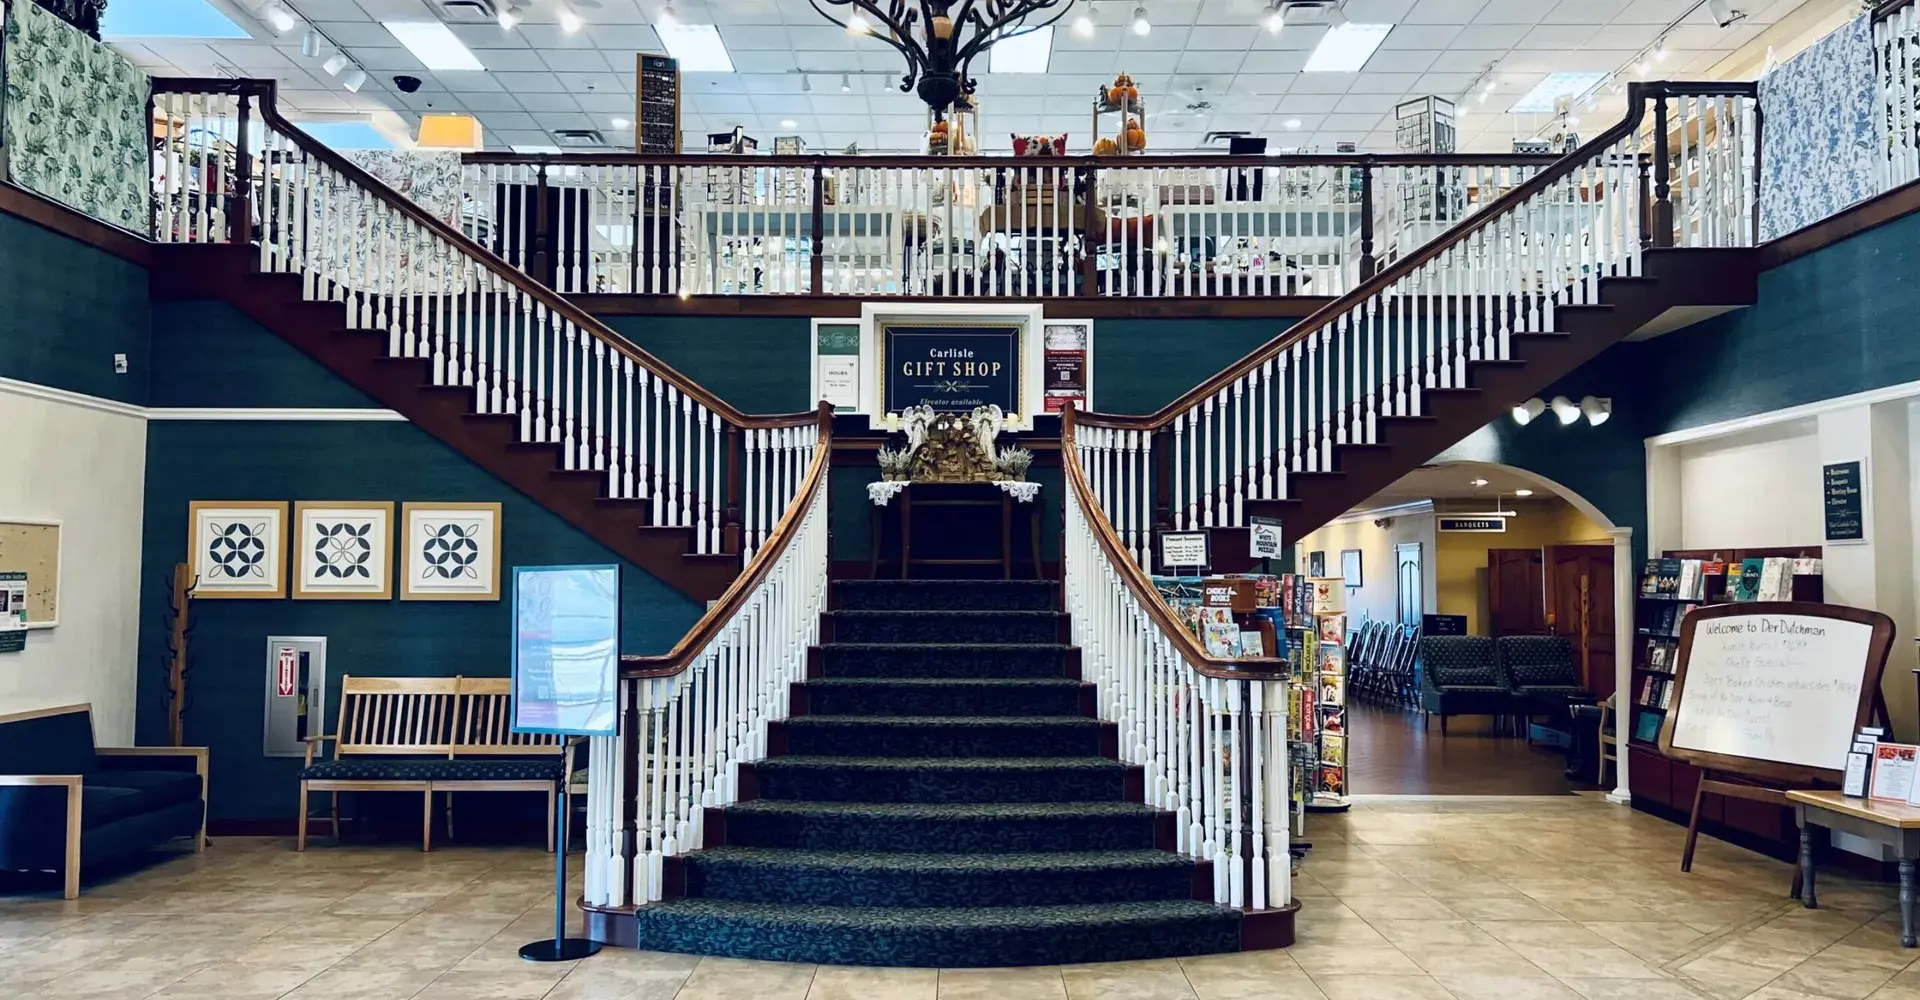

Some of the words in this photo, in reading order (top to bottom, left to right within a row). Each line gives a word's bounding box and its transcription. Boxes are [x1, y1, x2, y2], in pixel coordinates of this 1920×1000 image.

[930, 348, 974, 358] Carlisle
[903, 361, 946, 377] GIFT
[953, 361, 1001, 377] SHOP
[920, 398, 949, 406] Elevator
[951, 398, 983, 406] available
[1455, 521, 1489, 529] BANQUETS
[1256, 540, 1278, 548] MOUNTAIN
[1257, 546, 1275, 554] PUZZLES
[1206, 587, 1228, 596] CHOICE
[1706, 622, 1743, 636] Welcome
[1747, 620, 1758, 633] to
[1761, 618, 1778, 633] Der
[1780, 619, 1826, 637] Dutchman
